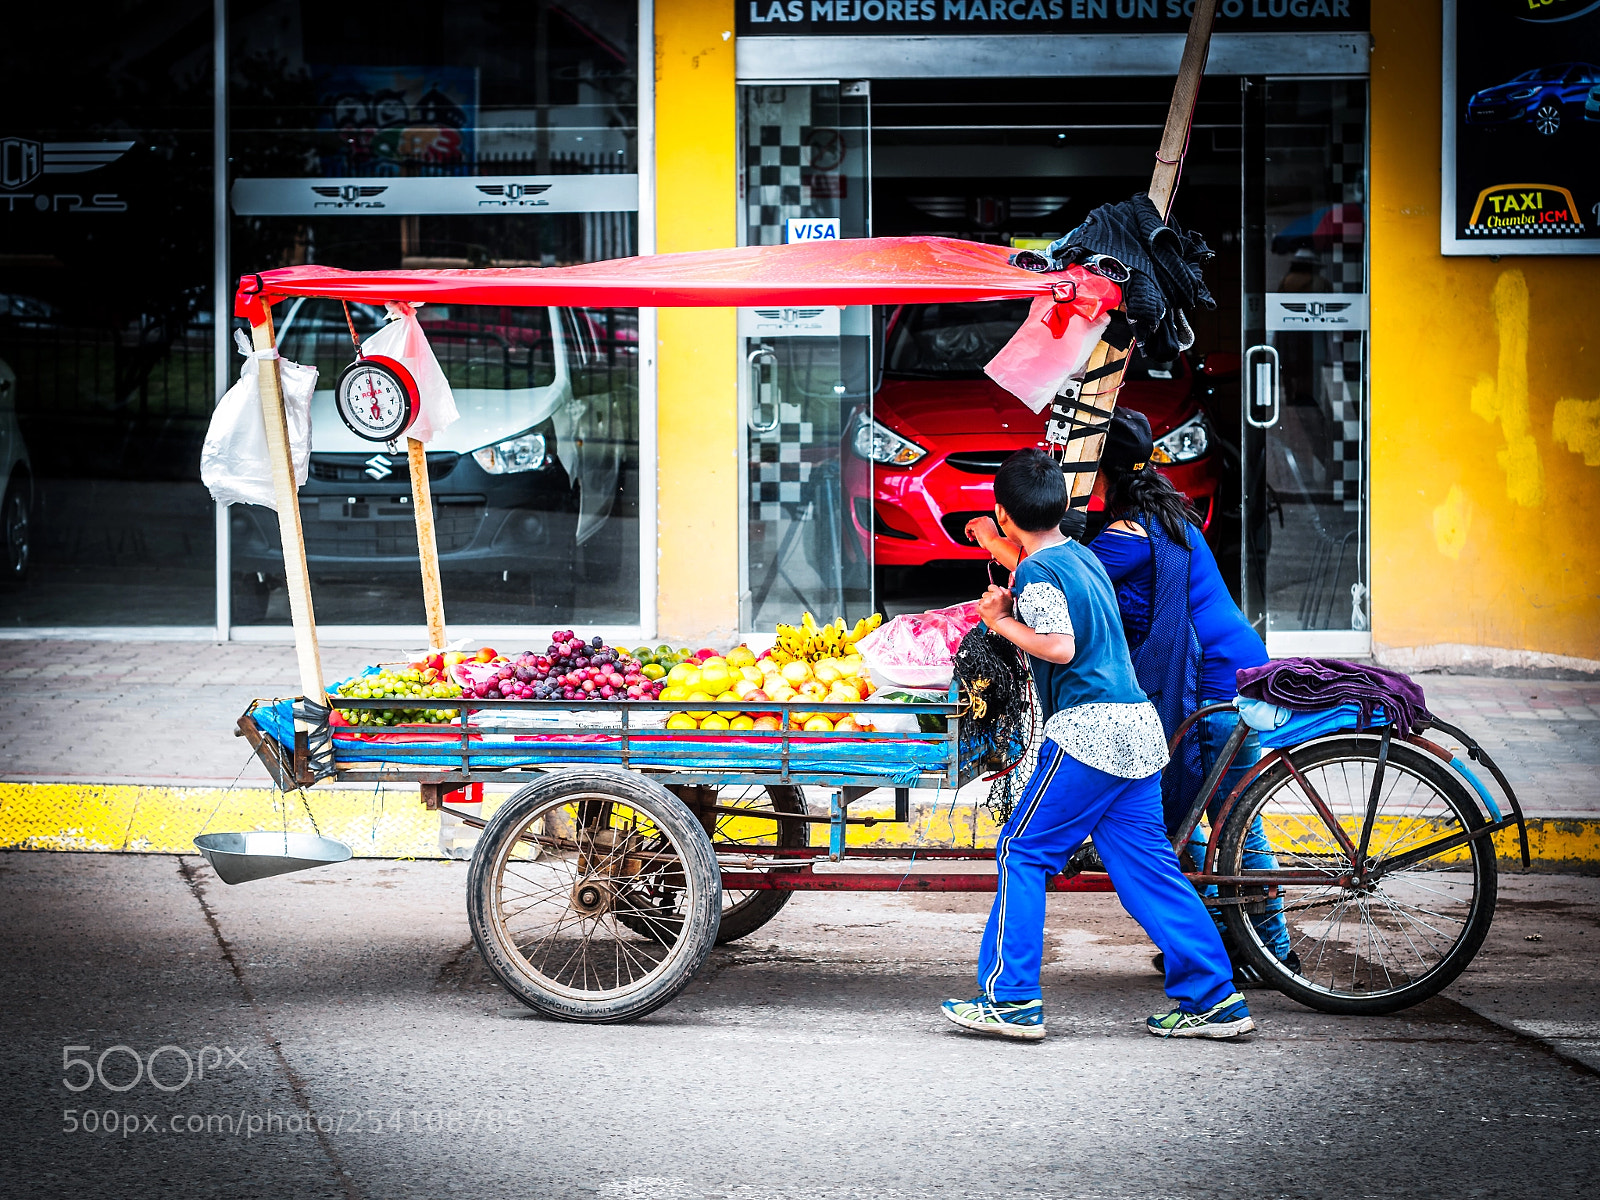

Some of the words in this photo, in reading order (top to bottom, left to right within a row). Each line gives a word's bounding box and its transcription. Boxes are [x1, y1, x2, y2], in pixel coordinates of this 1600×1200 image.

[750, 0, 803, 22] LAS
[811, 0, 937, 21] MEJORES
[943, 0, 1063, 20] MARCAS
[1071, 0, 1107, 19] EN
[1115, 0, 1157, 19] UN
[1166, 0, 1245, 18] SOO
[1252, 0, 1350, 18] LUGAR
[1488, 192, 1543, 213] TAXI
[1487, 213, 1536, 228] Chamba
[1539, 209, 1568, 224] JCM
[794, 224, 836, 239] VISA
